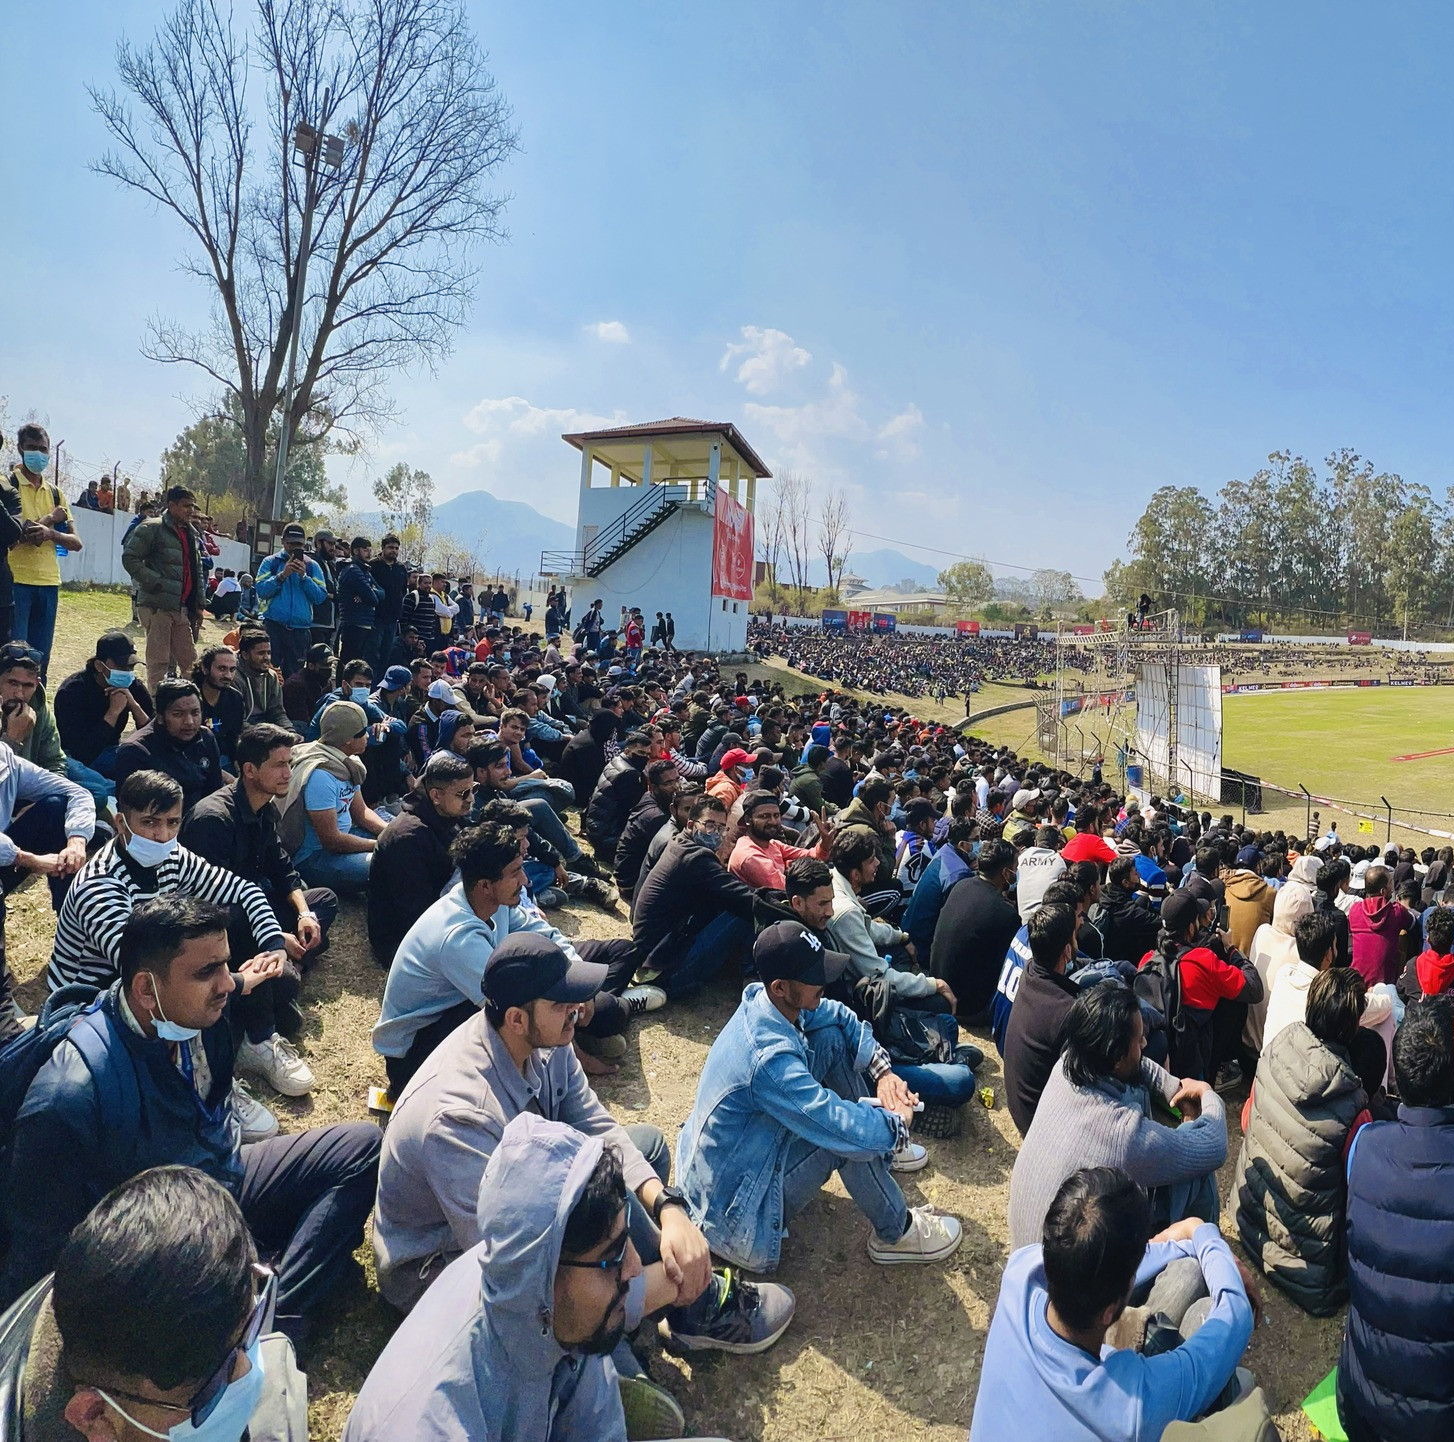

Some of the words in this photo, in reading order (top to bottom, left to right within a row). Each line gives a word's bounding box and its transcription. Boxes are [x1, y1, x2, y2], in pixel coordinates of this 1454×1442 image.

[1020, 857, 1056, 867] ARMY
[800, 931, 821, 952] LA
[997, 958, 1023, 1003] 10
